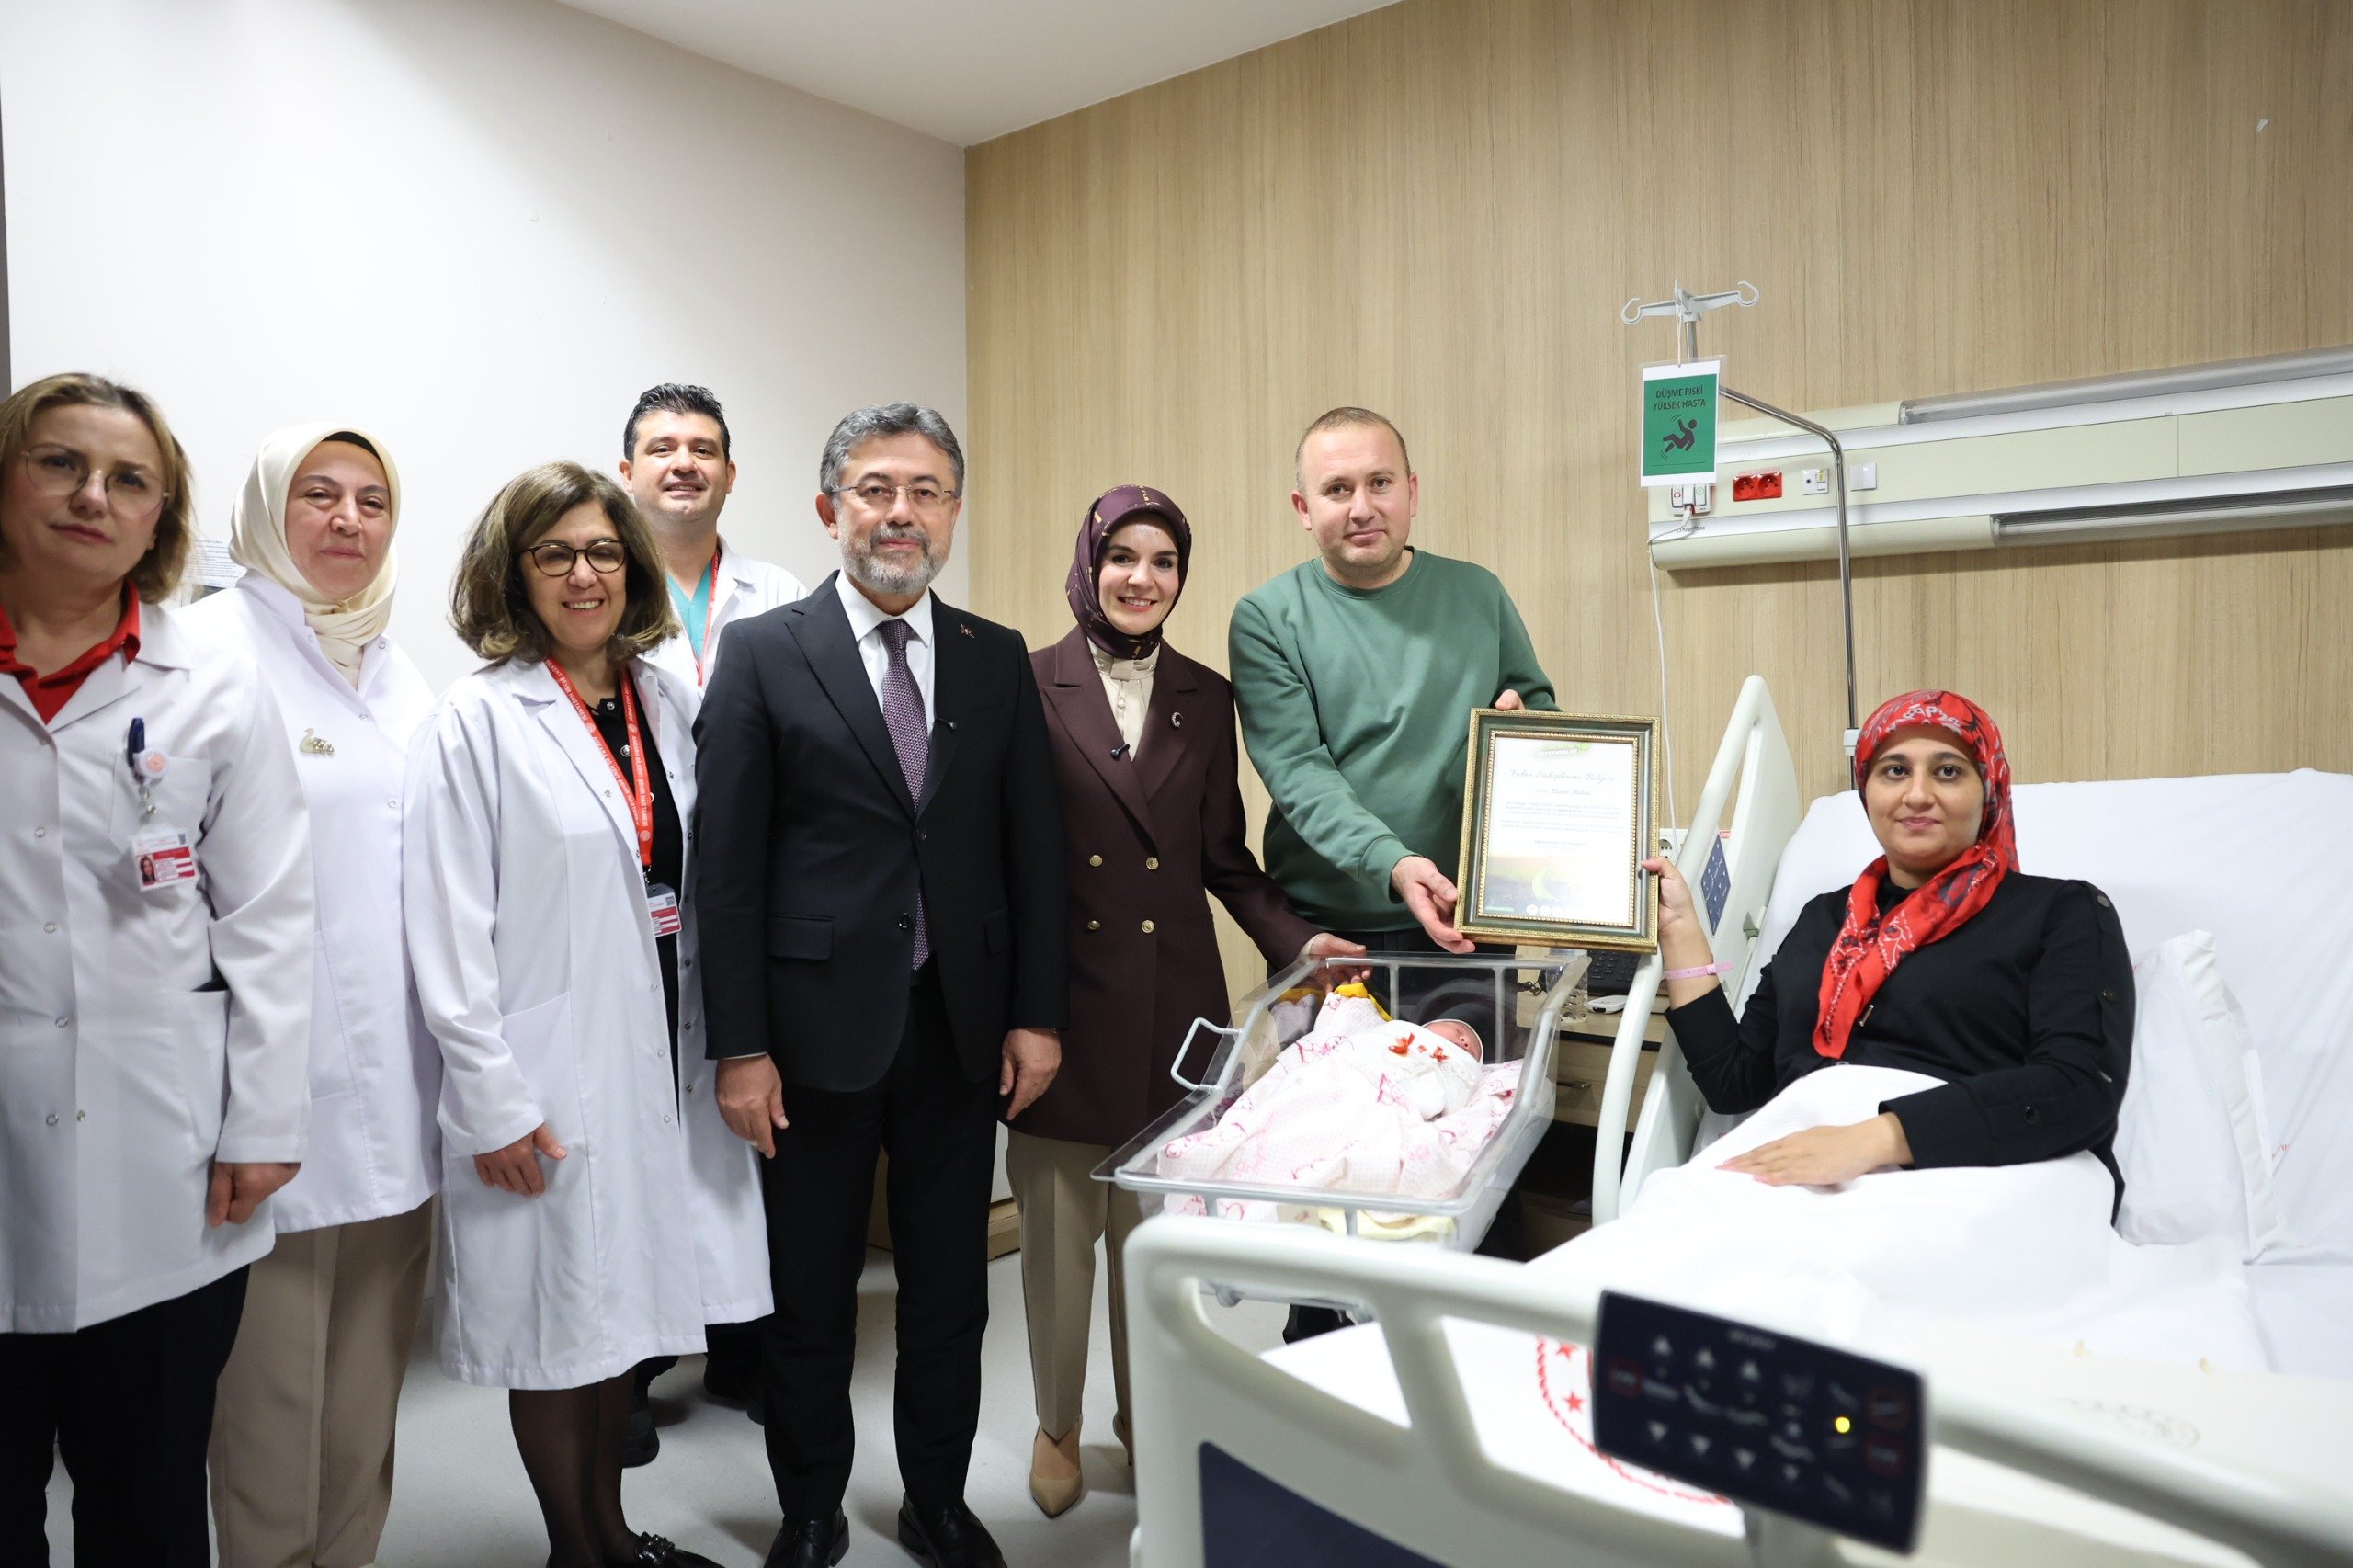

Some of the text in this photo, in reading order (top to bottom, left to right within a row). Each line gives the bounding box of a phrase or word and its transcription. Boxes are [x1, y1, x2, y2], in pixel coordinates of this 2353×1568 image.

[1656, 388, 1683, 399] DÜŞME
[1654, 398, 1706, 410] YÜKSEK HASTA
